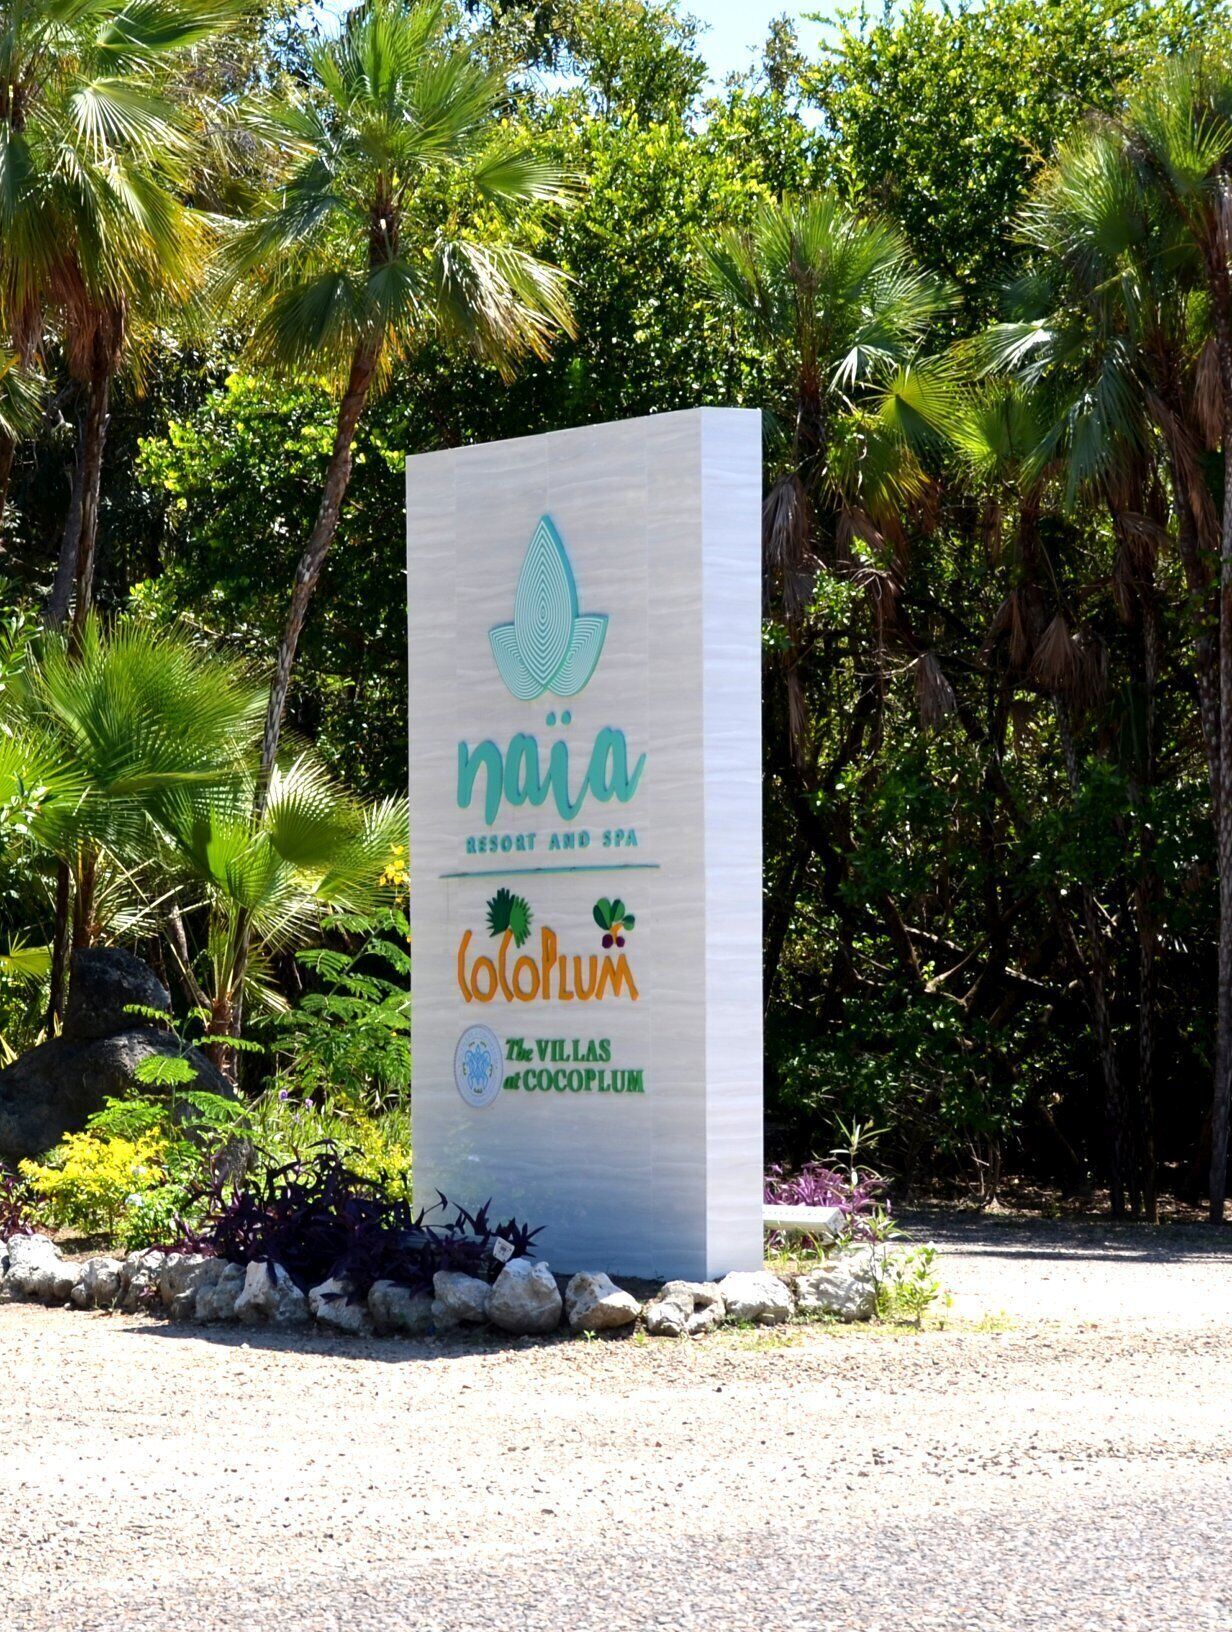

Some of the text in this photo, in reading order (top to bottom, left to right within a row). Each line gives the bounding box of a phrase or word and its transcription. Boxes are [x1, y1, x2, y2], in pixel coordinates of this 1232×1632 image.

[466, 828, 638, 854] RESORT AND SPA
[505, 1037, 612, 1063] The VILLAS
[503, 1068, 645, 1093] at COCOPLUM
